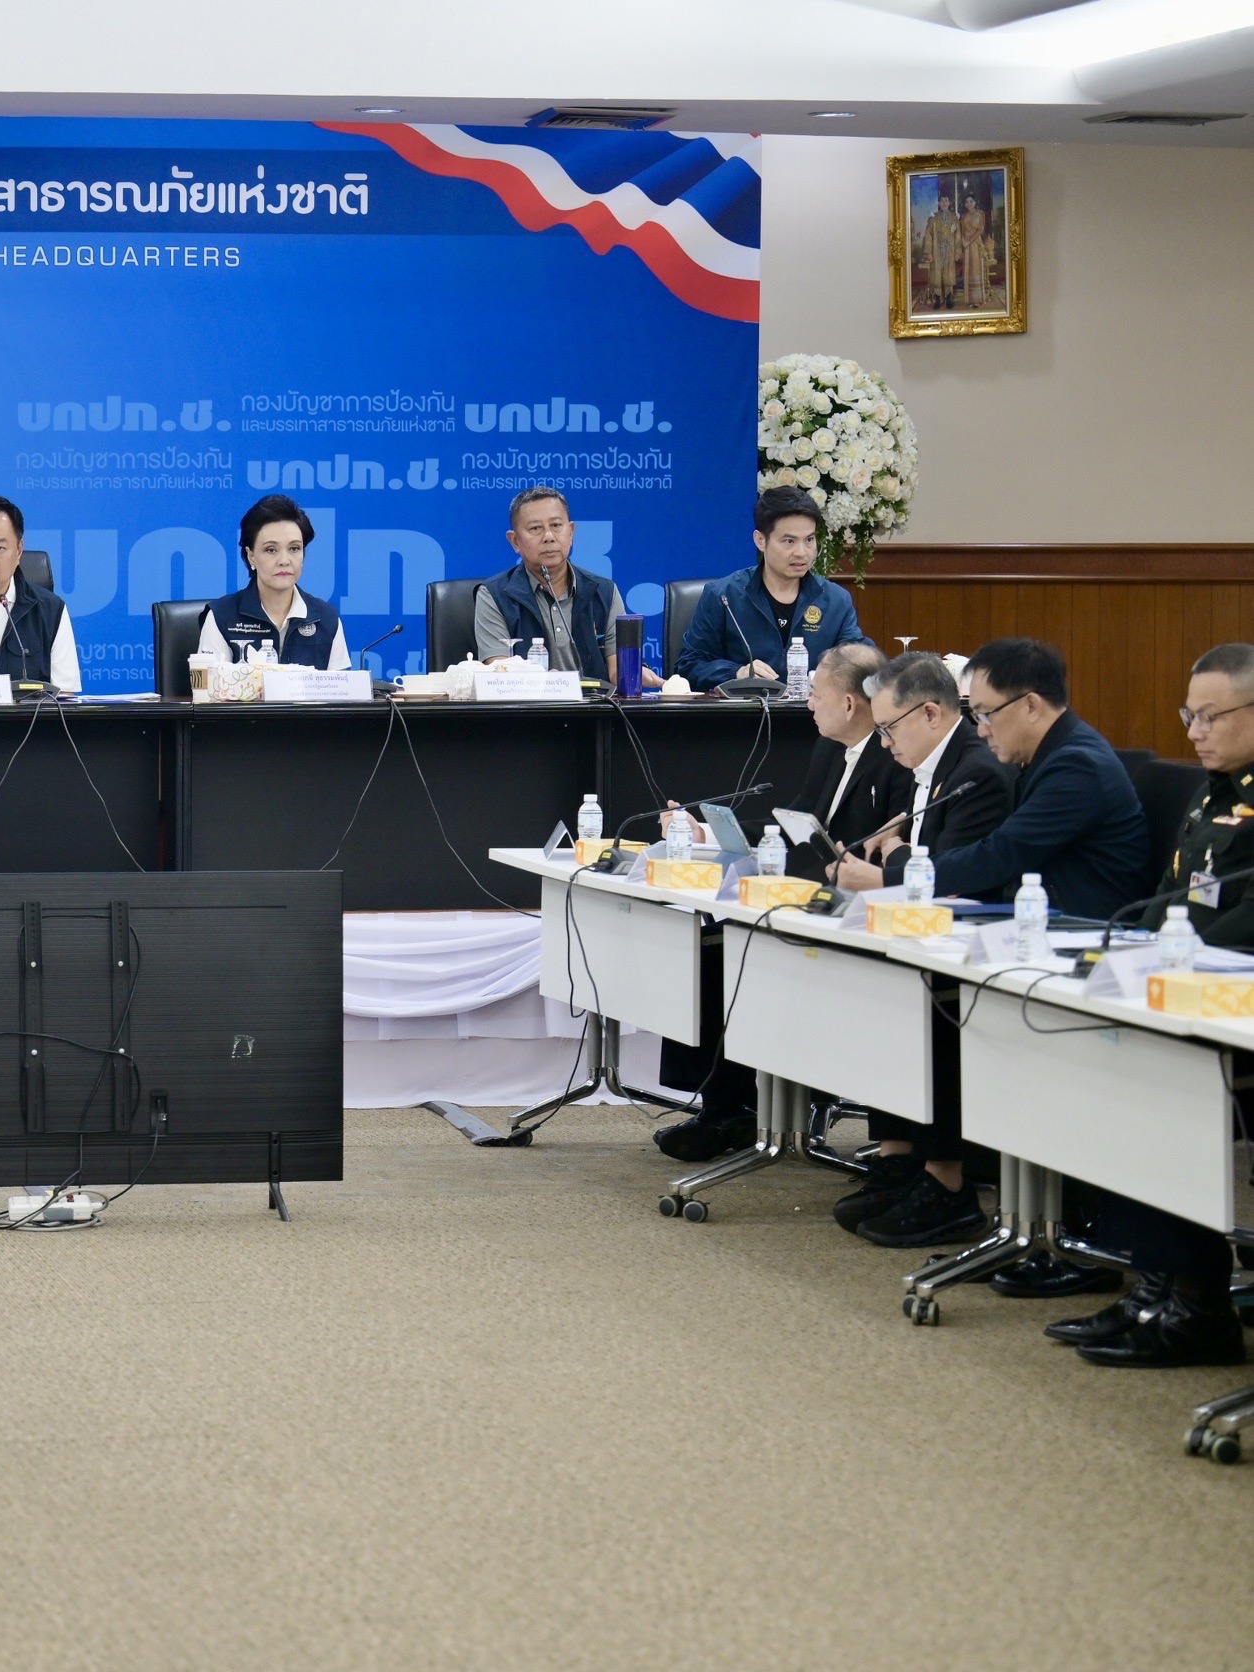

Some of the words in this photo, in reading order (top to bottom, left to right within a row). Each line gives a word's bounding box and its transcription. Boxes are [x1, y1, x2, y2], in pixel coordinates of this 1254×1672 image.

[241, 390, 455, 415] กองบัญชาการป้องกัน
[241, 416, 456, 432] และบรรเทาสาธารณภัยแห่งชาติ
[16, 447, 232, 472] กองบัญชาการป้องกัน
[462, 447, 672, 472] กองบัญชาการป้องกัน
[16, 473, 233, 489] และบรรเทาสาธารณภัยแห่งชาติ
